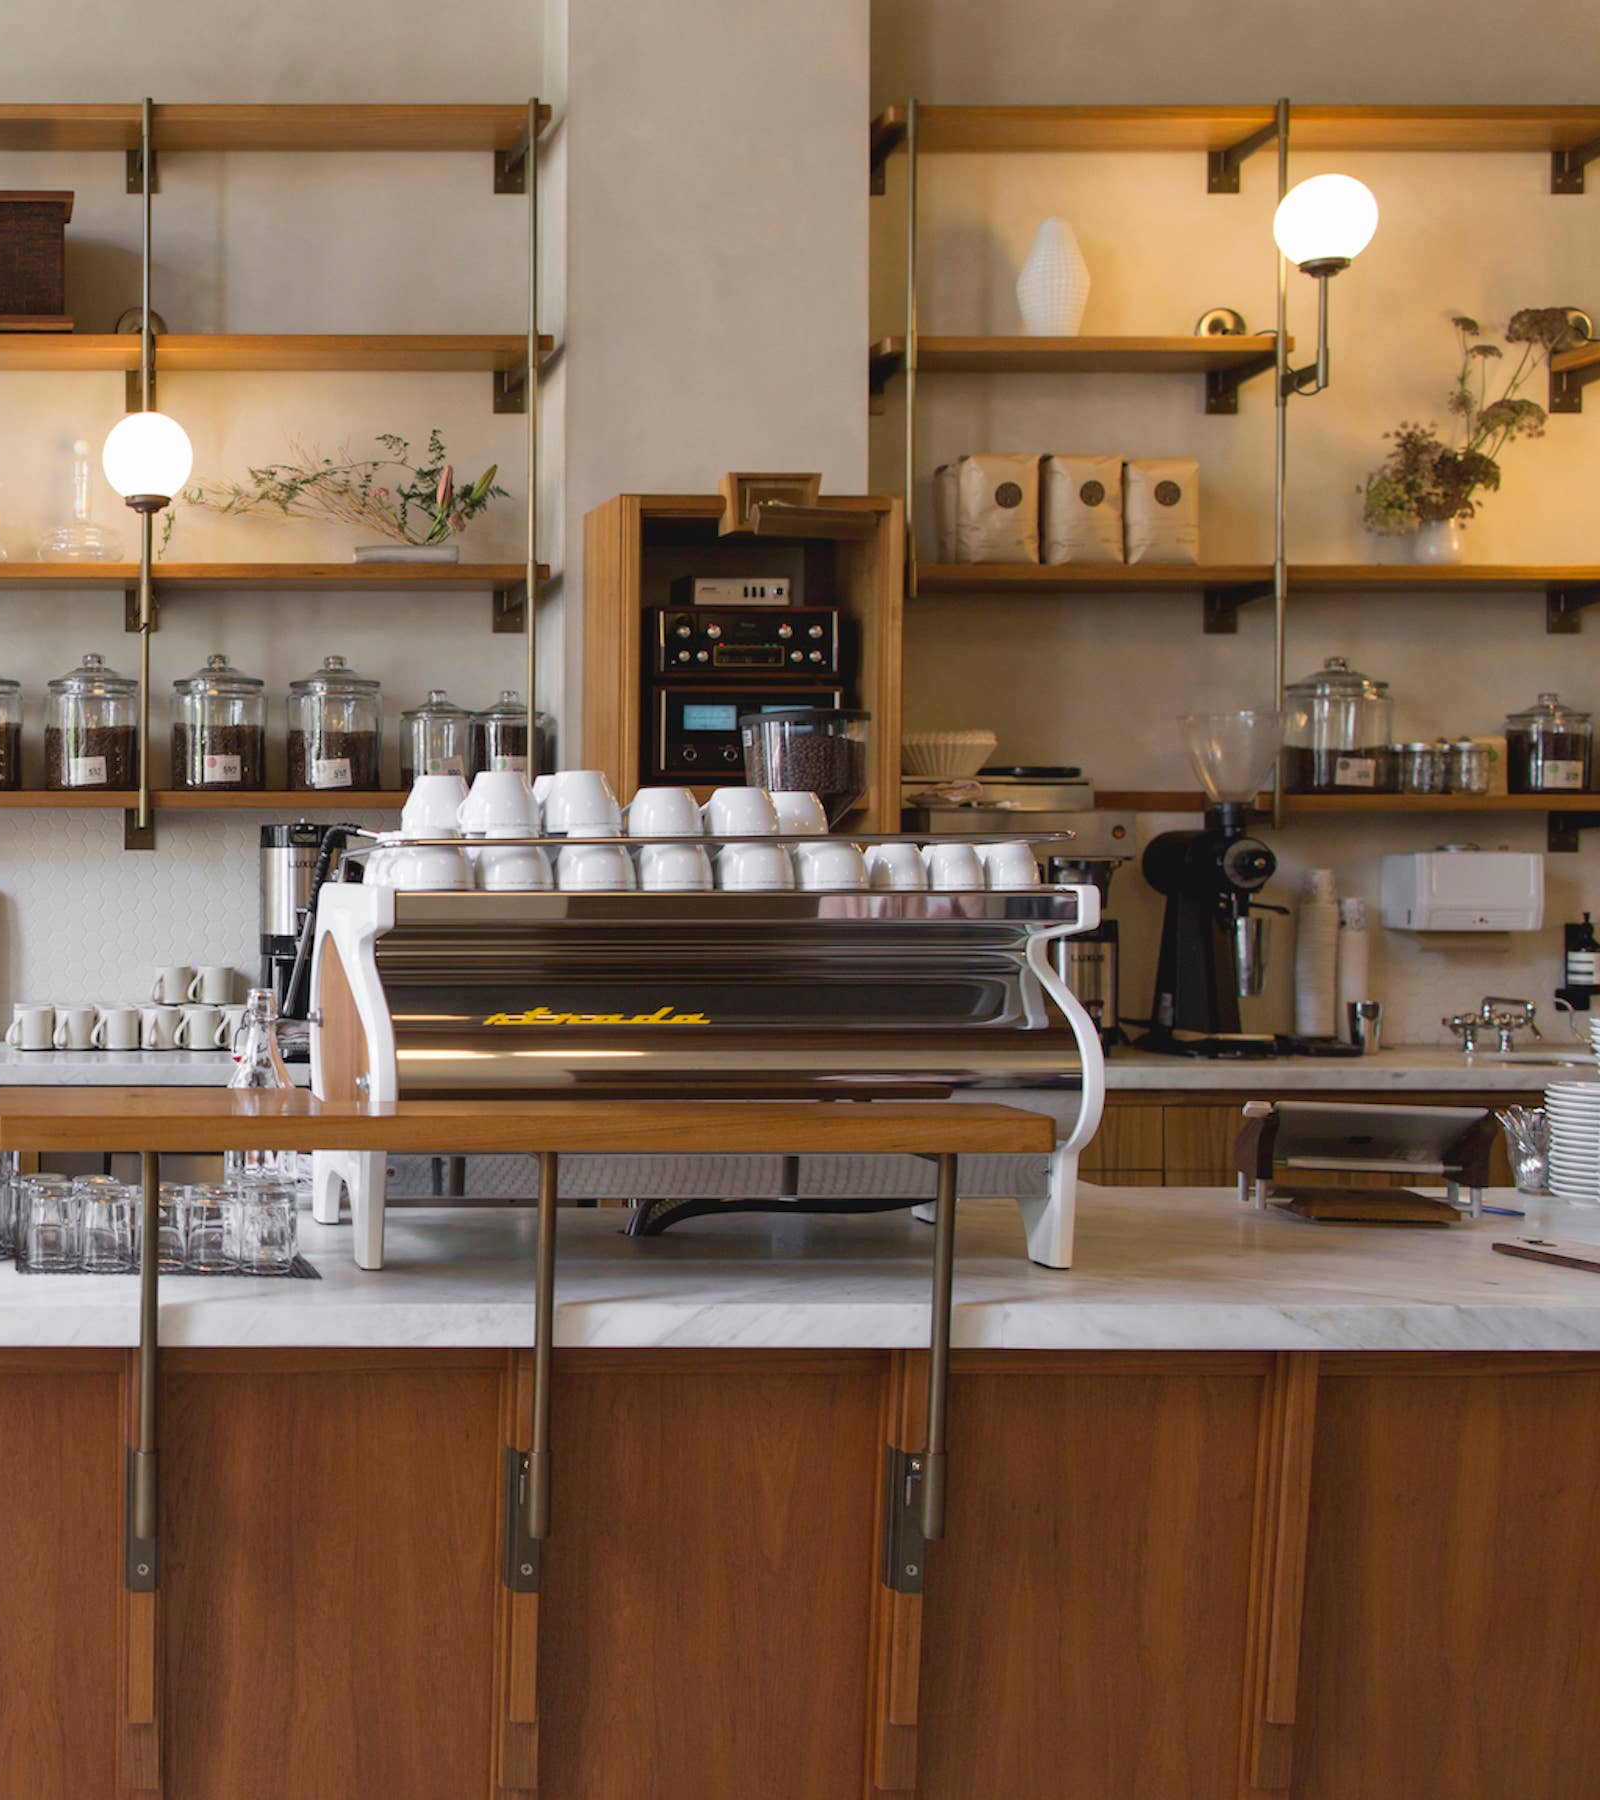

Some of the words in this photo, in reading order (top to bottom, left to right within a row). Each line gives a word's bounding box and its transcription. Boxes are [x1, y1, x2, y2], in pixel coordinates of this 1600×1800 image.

[288, 860, 317, 869] LUXU
[1071, 954, 1105, 962] LUXUS
[482, 1006, 711, 1026] strada
